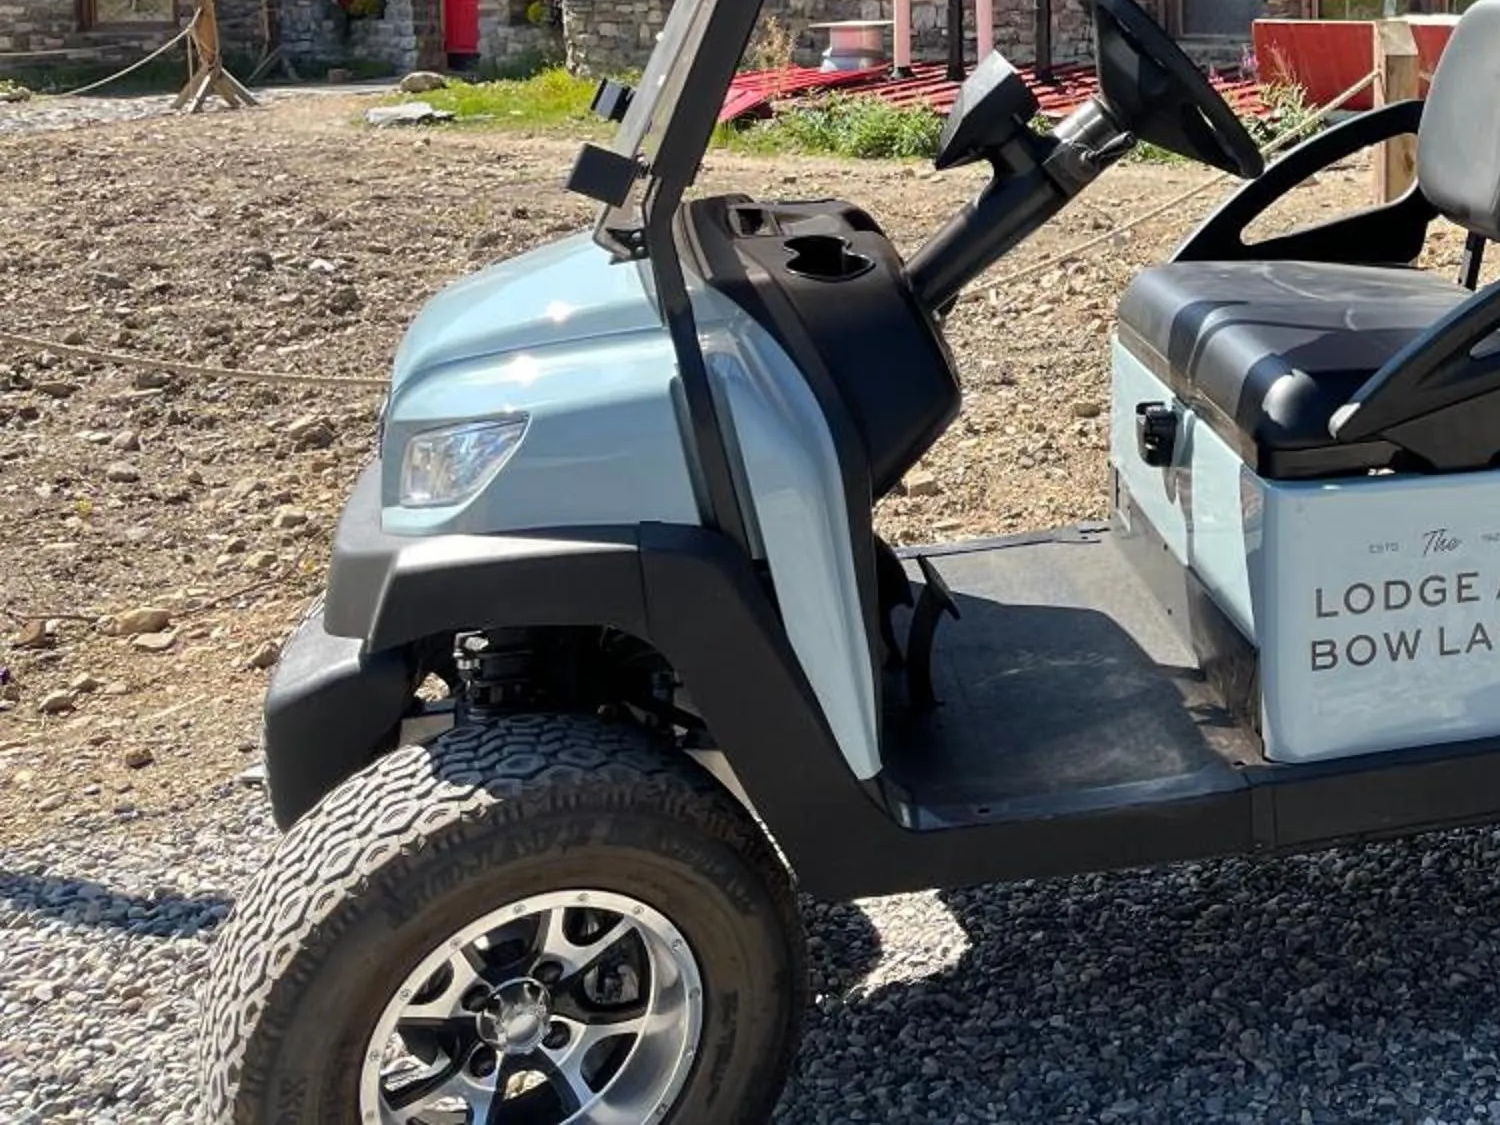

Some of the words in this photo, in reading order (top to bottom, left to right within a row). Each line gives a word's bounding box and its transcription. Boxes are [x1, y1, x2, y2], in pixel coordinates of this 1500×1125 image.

[1422, 527, 1462, 556] The
[1315, 571, 1481, 619] LODGE
[1311, 628, 1422, 671] BOW
